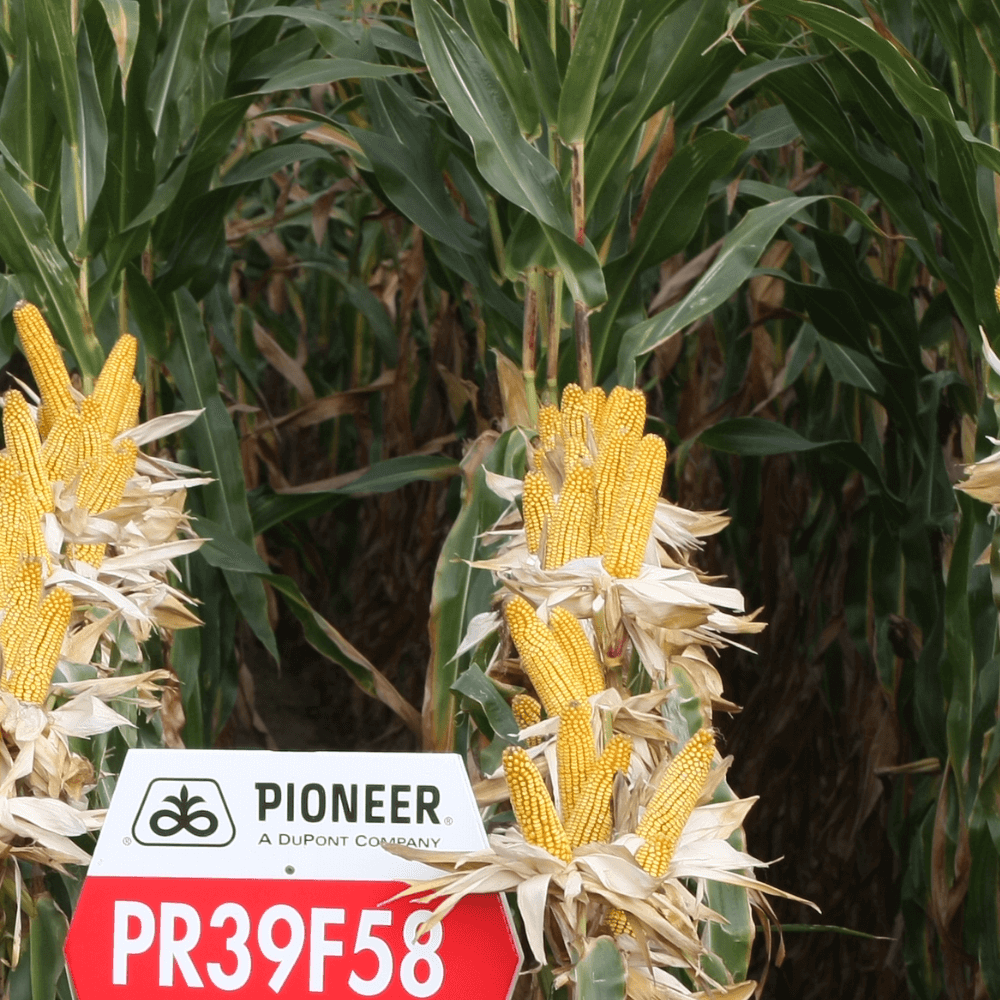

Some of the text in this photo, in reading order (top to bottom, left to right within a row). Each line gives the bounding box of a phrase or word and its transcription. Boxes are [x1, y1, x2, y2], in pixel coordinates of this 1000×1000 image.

[254, 782, 441, 825] PIONEER
[258, 833, 272, 845] A
[112, 900, 444, 998] PR39F58
